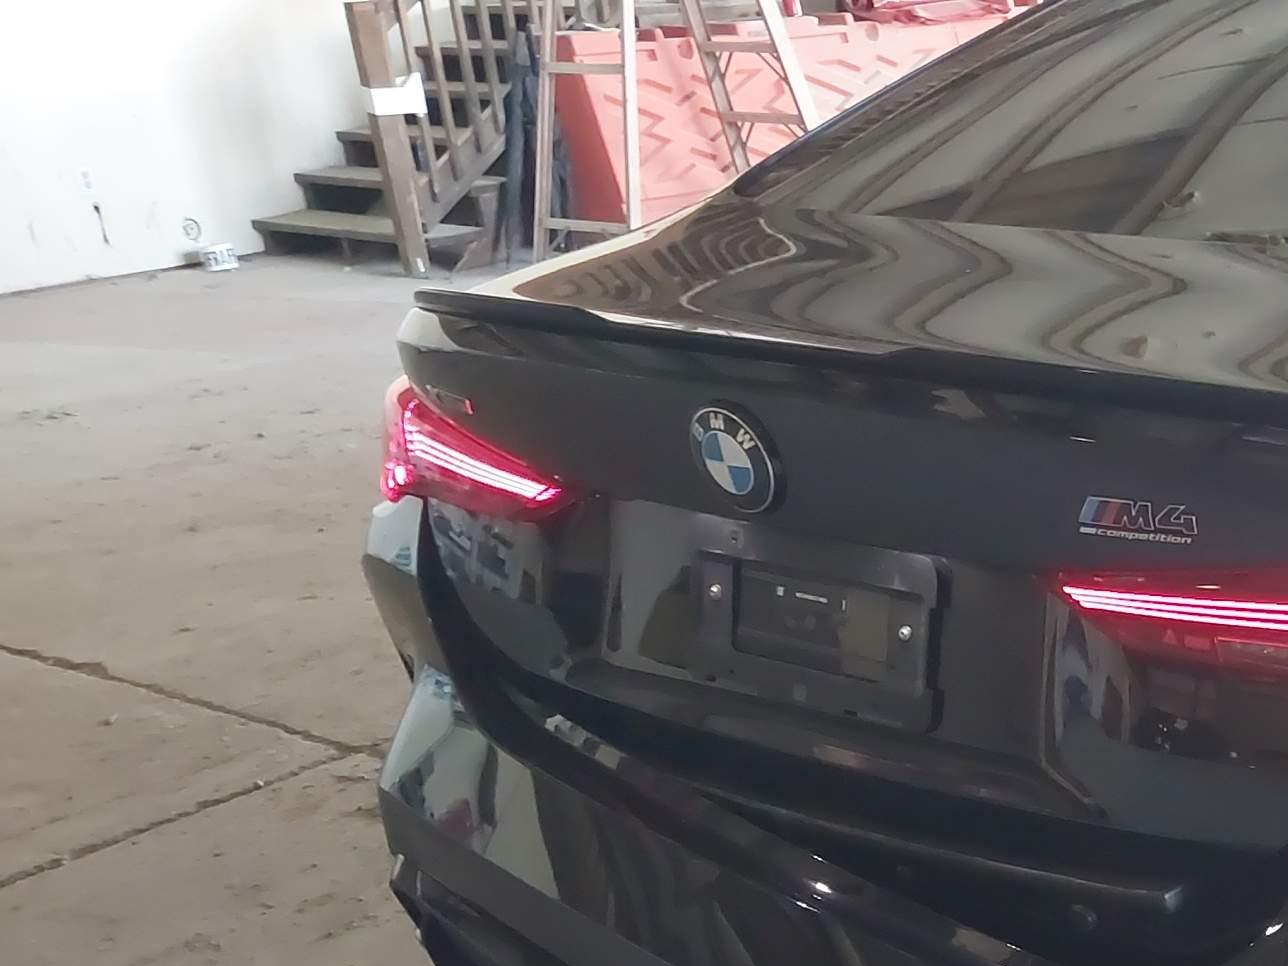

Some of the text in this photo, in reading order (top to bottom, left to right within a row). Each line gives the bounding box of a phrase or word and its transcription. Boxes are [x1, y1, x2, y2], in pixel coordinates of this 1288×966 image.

[692, 411, 756, 450] BMW
[1108, 498, 1198, 535] M4
[1097, 528, 1192, 544] competition
